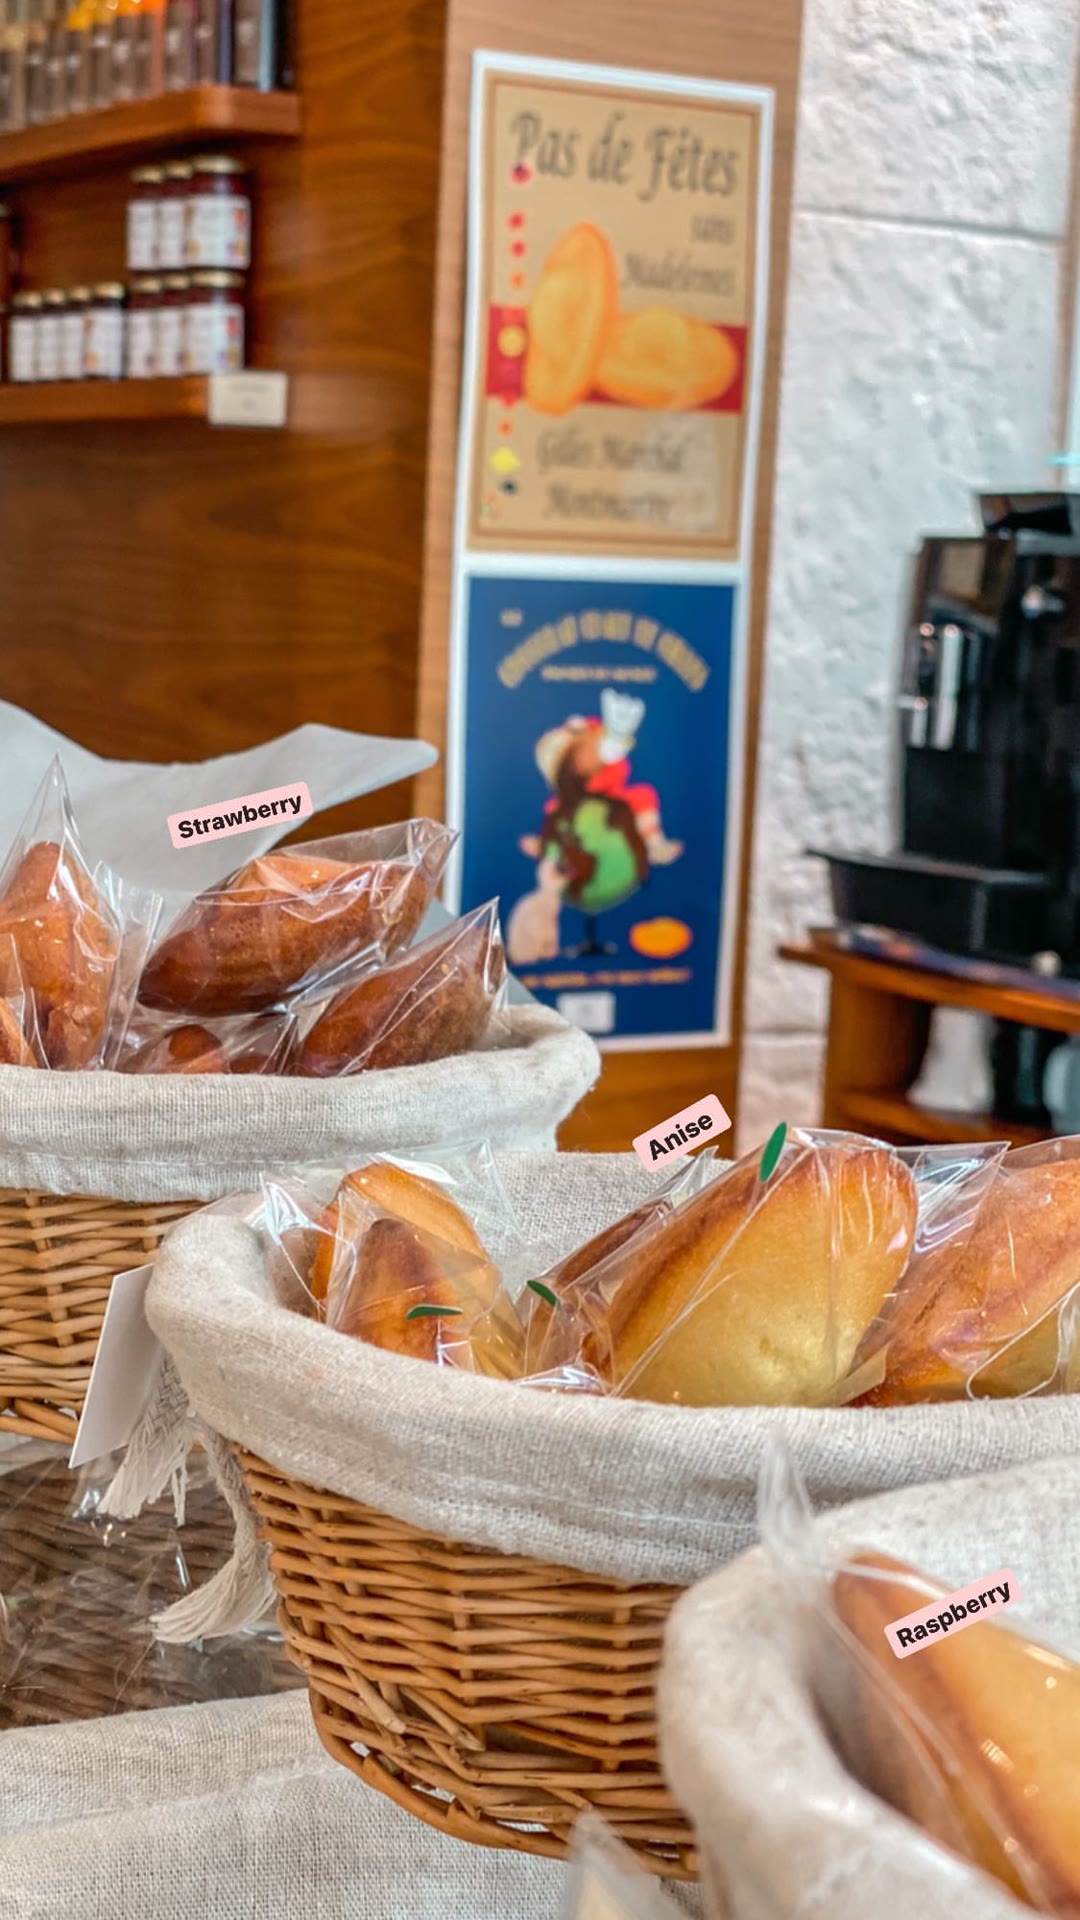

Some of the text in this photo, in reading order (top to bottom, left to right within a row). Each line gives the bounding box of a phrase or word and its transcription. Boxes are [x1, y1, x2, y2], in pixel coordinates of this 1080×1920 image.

[510, 109, 738, 203] Pas de Fêtes
